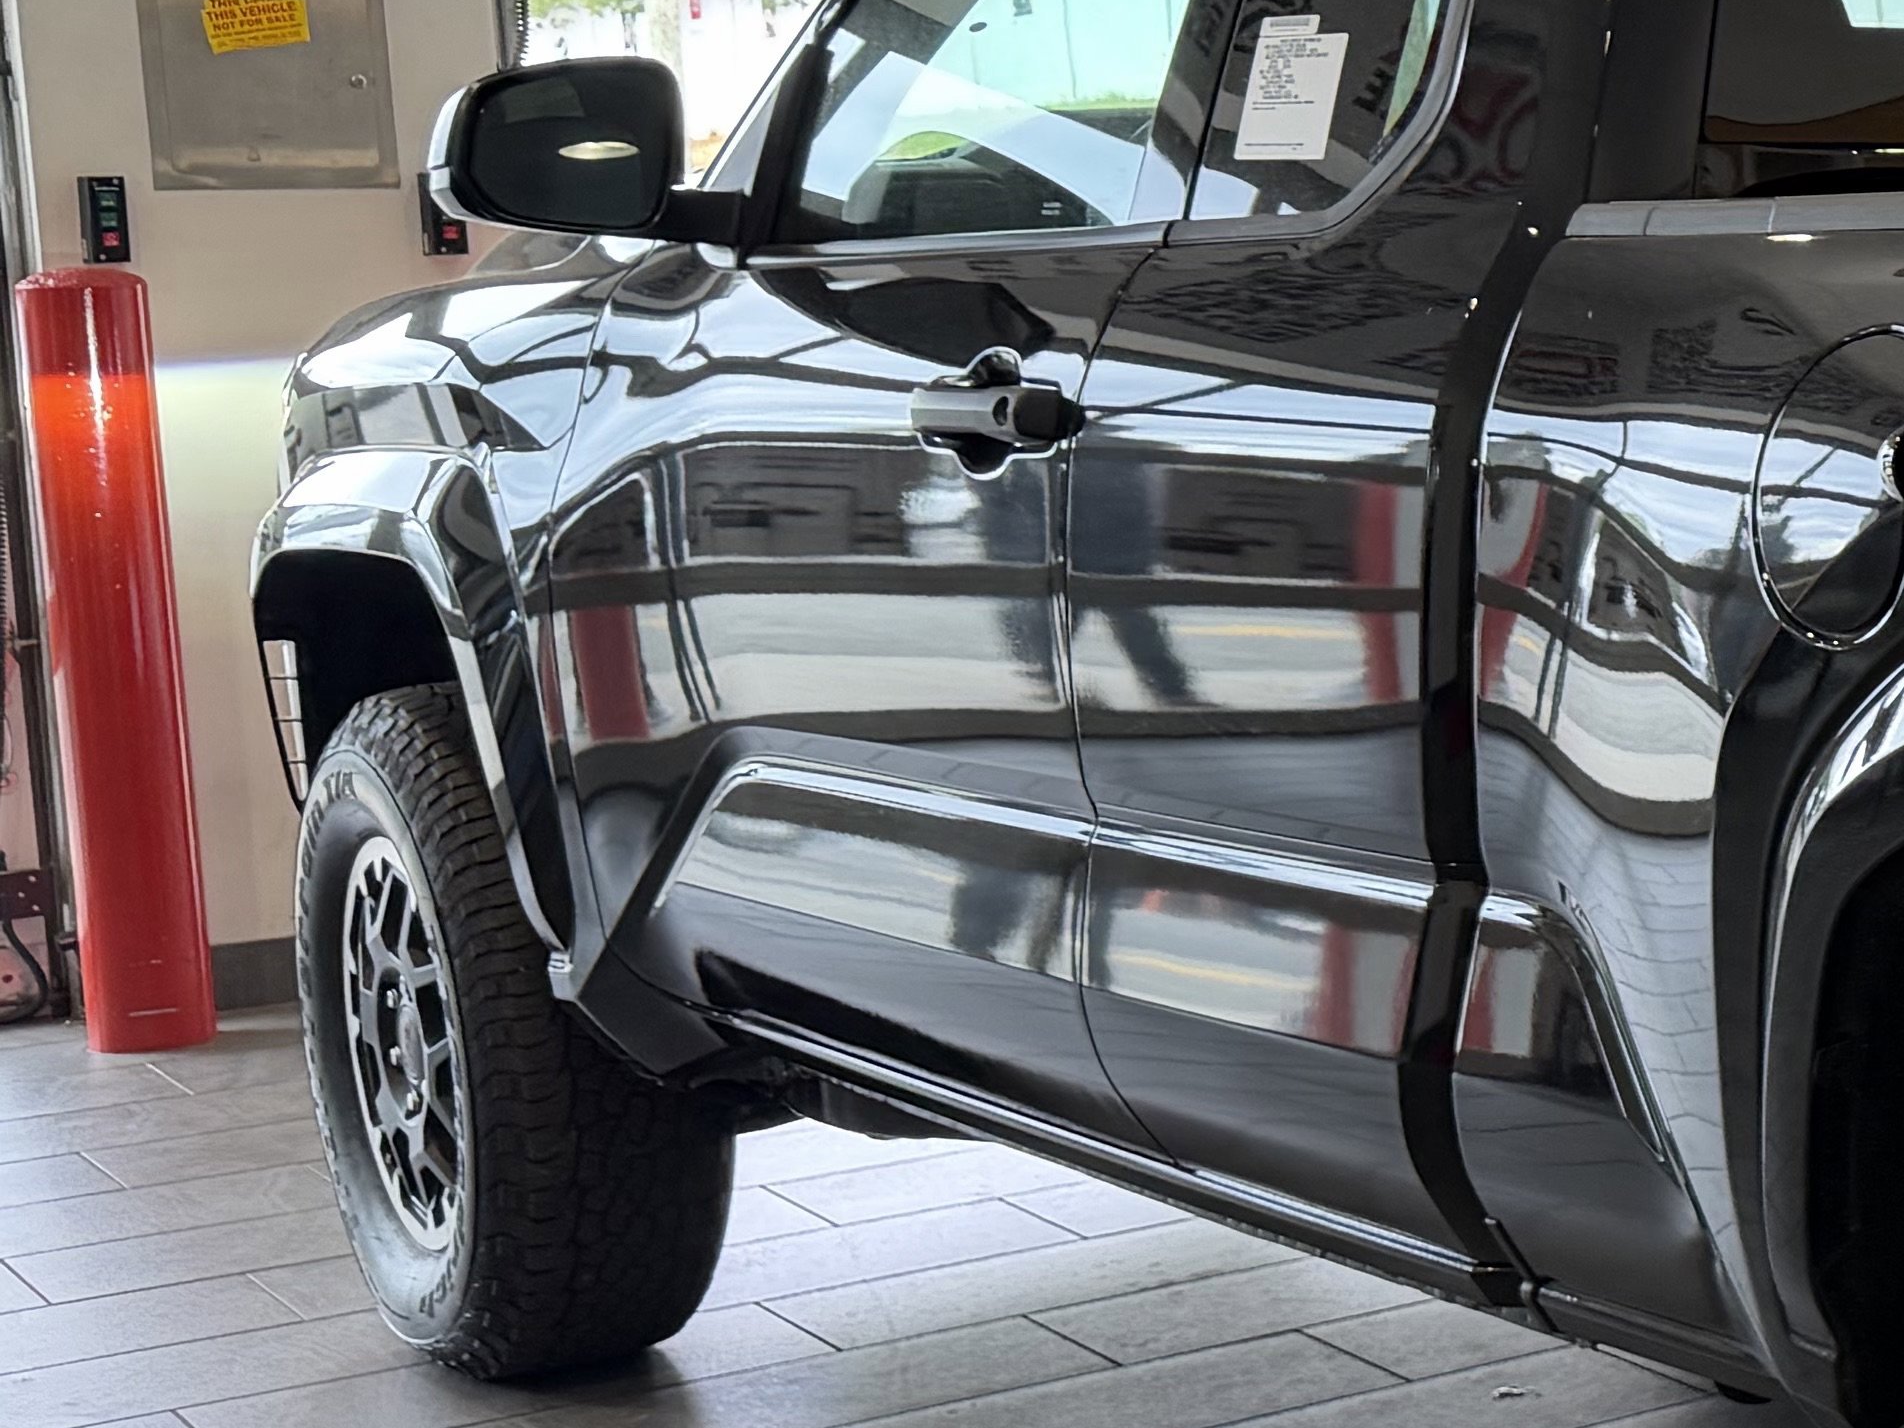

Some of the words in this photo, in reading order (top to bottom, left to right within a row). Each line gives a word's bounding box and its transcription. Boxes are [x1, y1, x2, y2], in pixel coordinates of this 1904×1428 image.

[205, 8, 238, 22] THIS
[239, 0, 297, 18] VEHICLE
[212, 21, 236, 32] NOT
